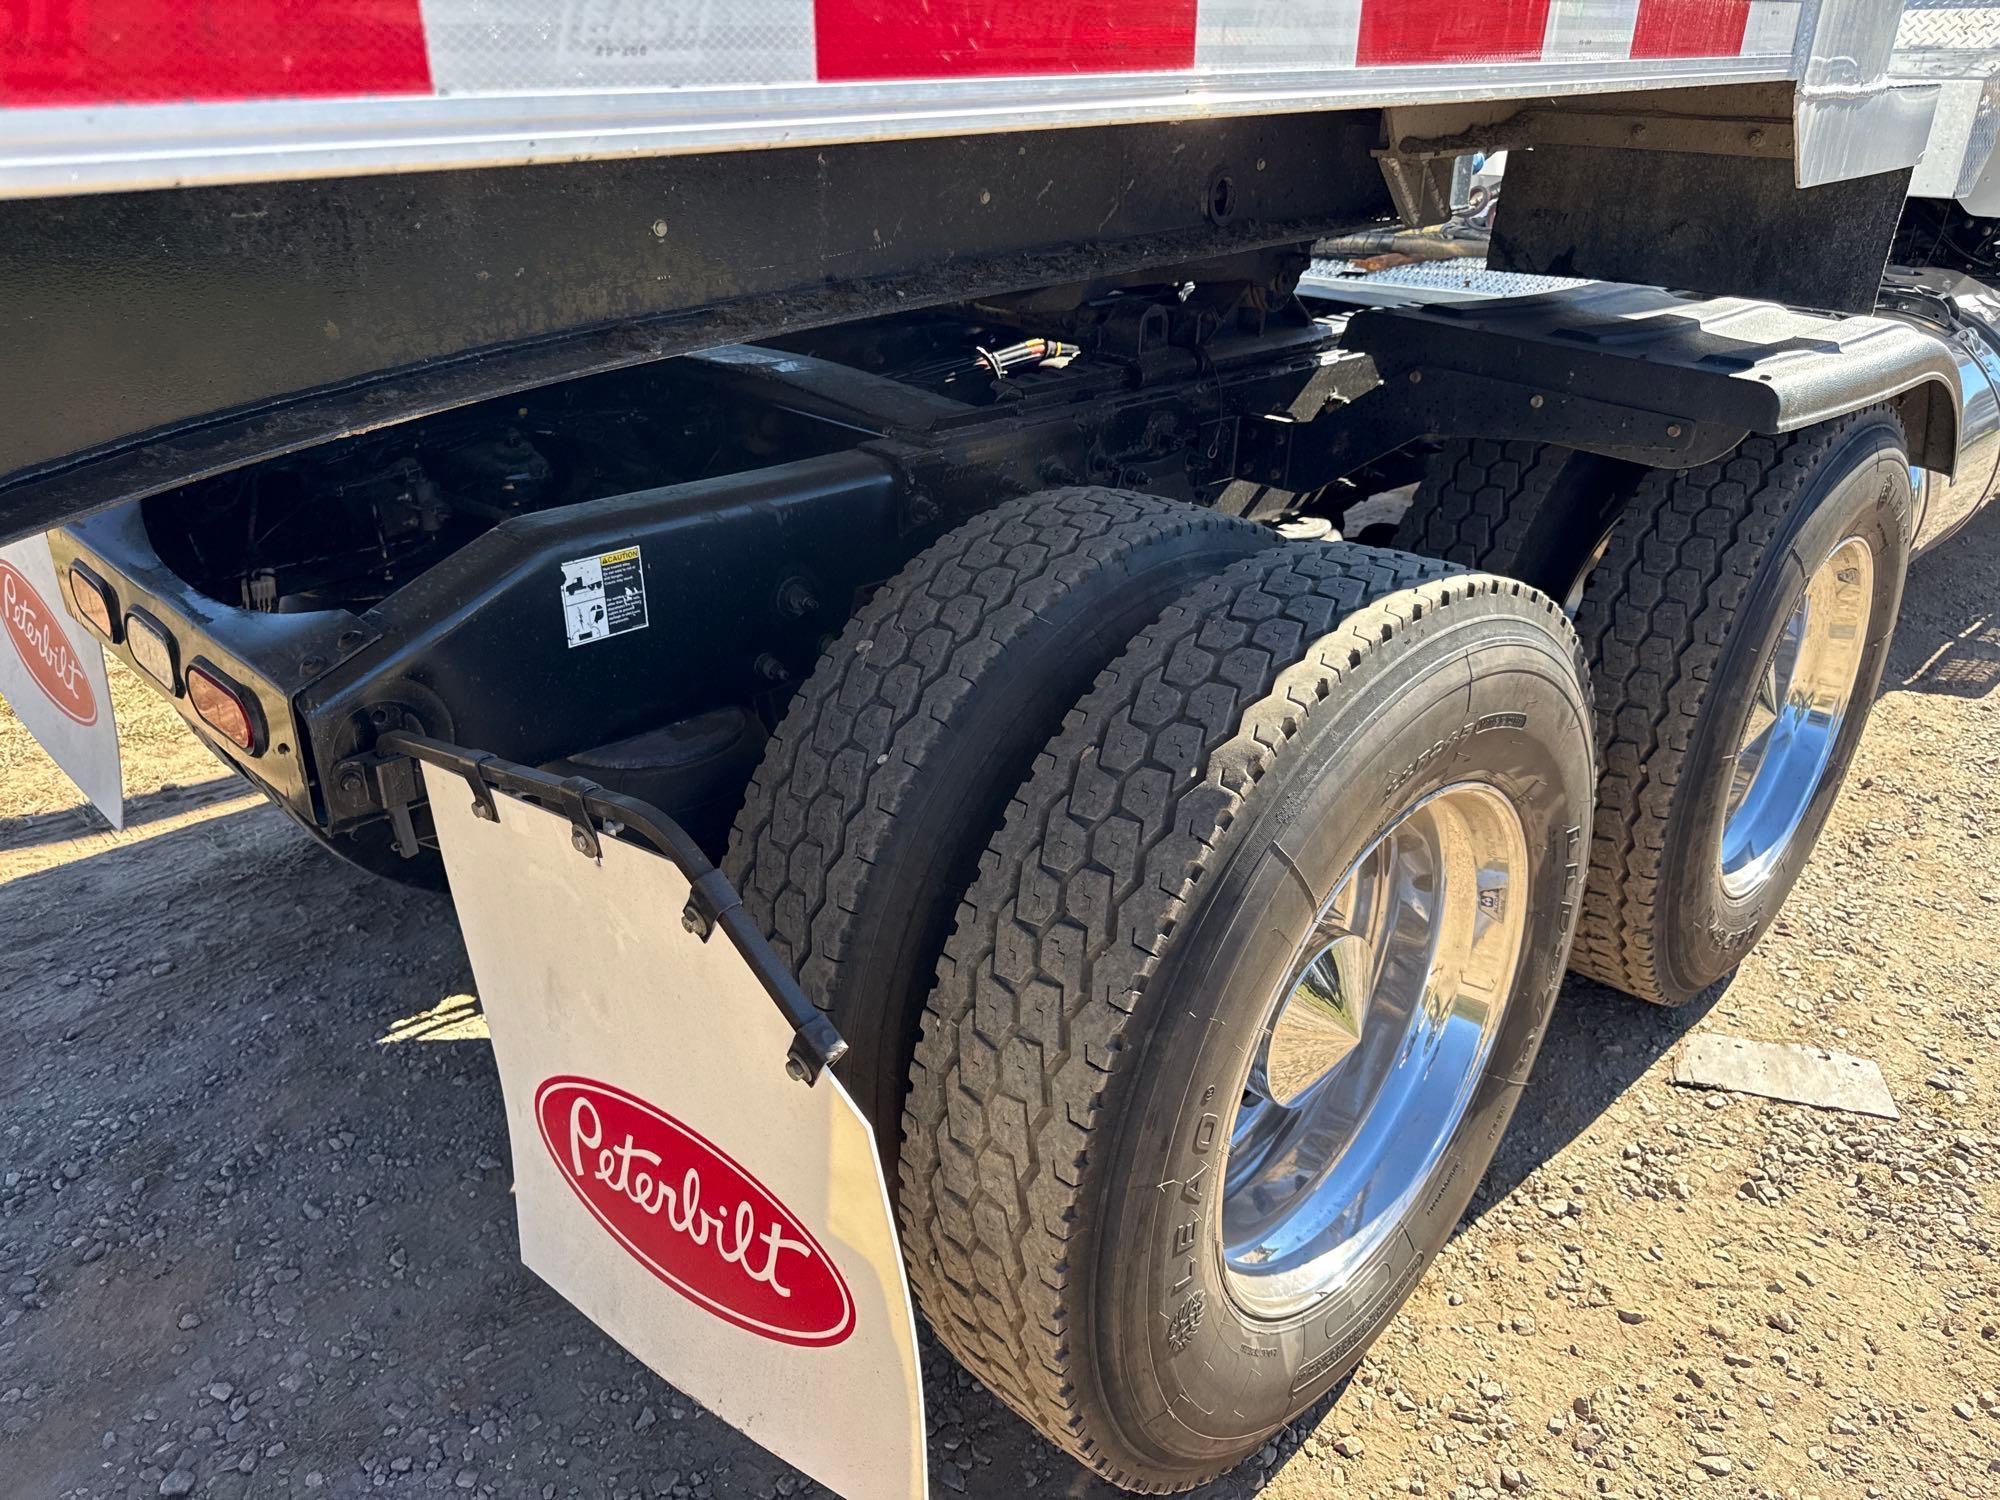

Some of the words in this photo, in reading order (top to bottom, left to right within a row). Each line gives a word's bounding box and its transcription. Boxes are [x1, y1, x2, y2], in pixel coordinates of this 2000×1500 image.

[607, 549, 638, 563] CAUTION
[2, 573, 84, 700] Peterbilt
[569, 1096, 812, 1298] Peterbilt
